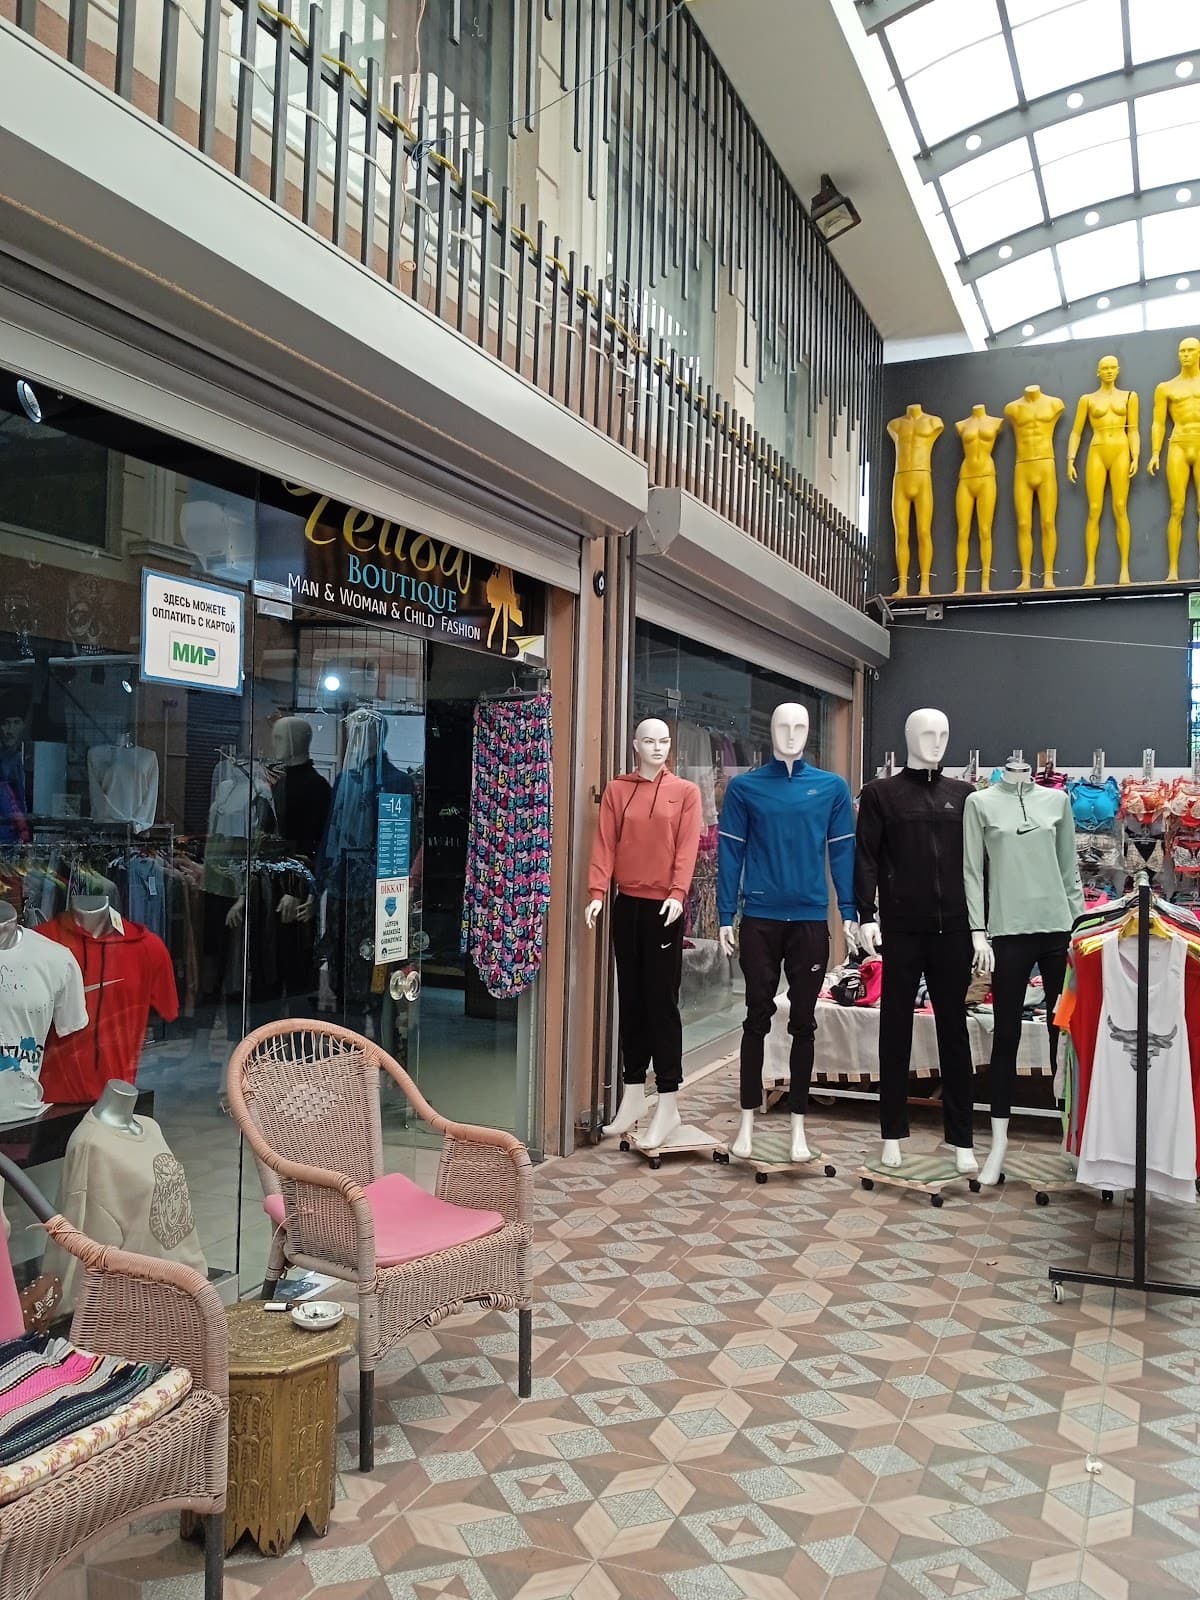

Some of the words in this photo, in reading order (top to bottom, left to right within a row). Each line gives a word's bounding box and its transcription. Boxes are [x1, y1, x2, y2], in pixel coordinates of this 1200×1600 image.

[347, 553, 457, 614] BOUTIQUE
[163, 593, 191, 608] ЗДЕСЬ
[193, 600, 226, 616] МОЖЕТЕ
[288, 572, 319, 598] MAN
[324, 583, 335, 602] &
[340, 589, 387, 616] WOMAN
[391, 602, 401, 619] &
[404, 606, 435, 629] CHILD
[441, 617, 481, 640] FASHION
[152, 607, 196, 625] ОПЛАТИТЬ
[198, 617, 204, 627] С
[205, 620, 236, 634] КАРТОЙ
[172, 641, 216, 666] МИР
[389, 797, 402, 814] 14
